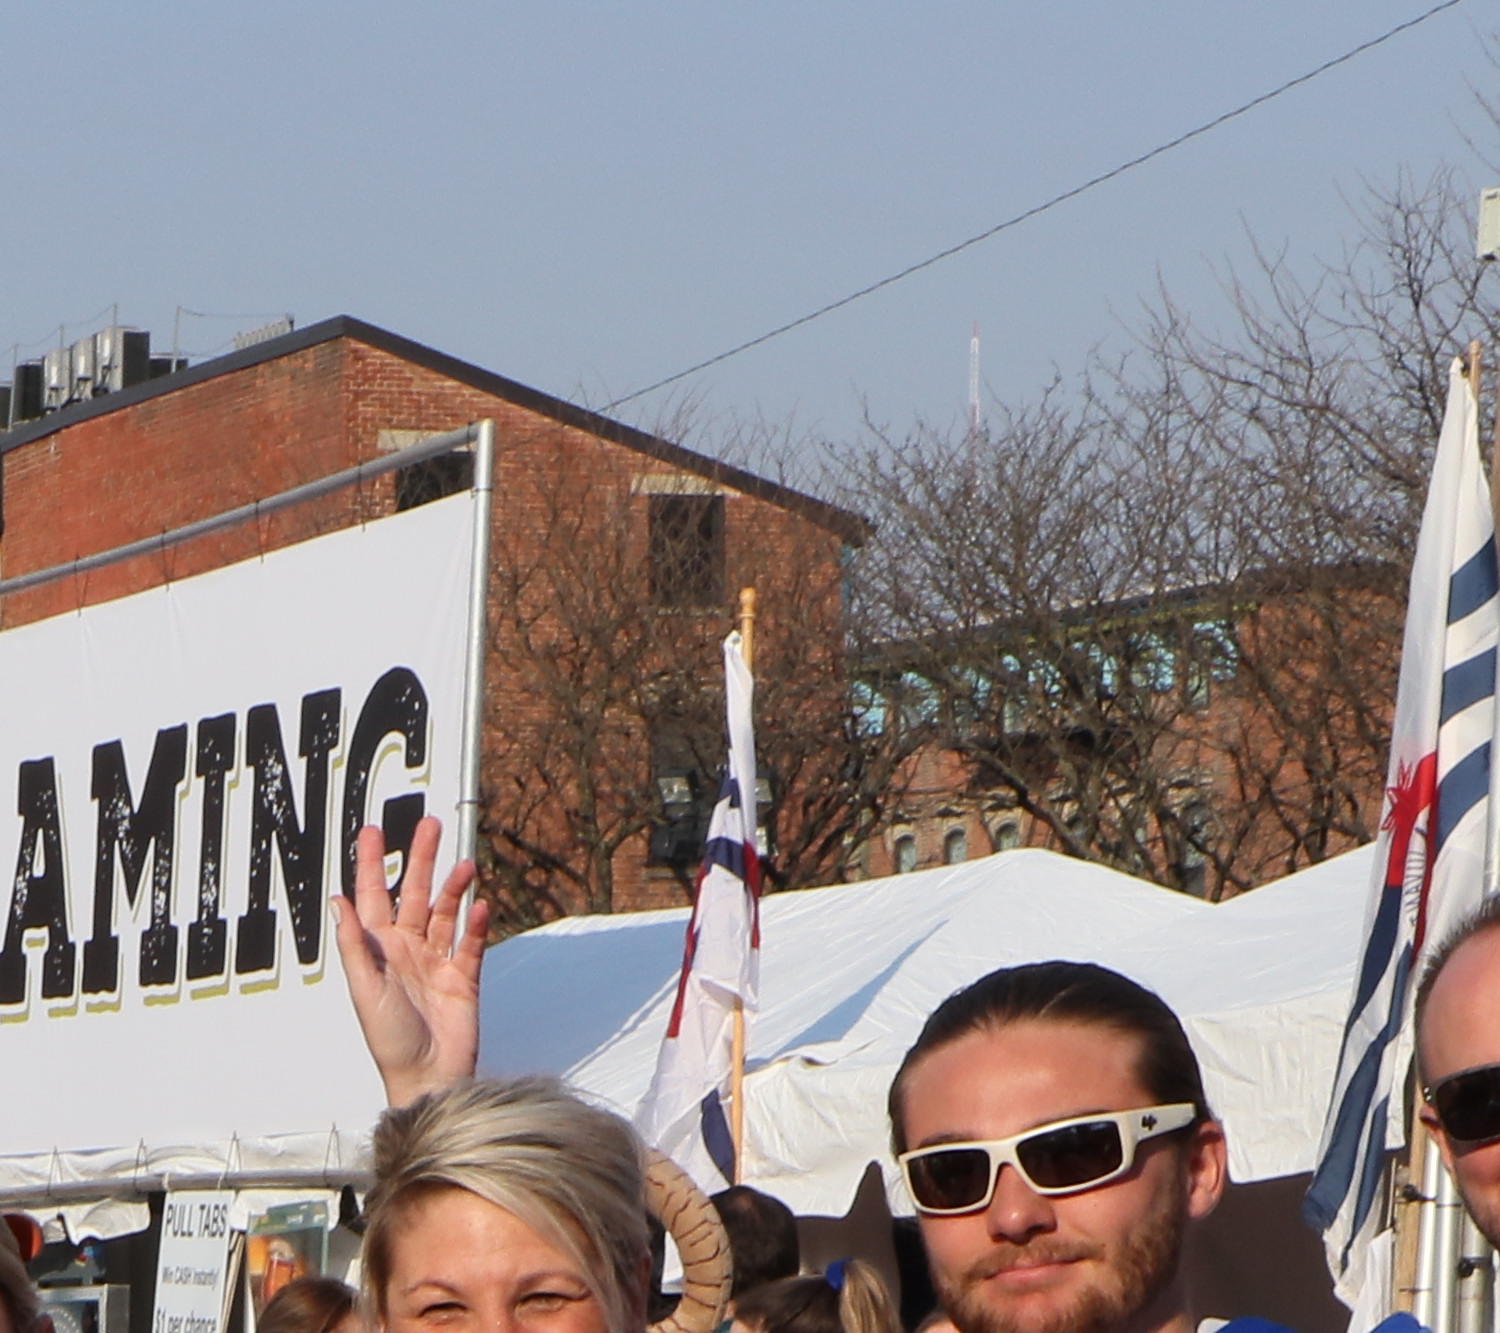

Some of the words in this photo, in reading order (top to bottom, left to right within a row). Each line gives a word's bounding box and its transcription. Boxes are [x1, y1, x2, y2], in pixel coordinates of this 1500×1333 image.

[165, 1204, 194, 1237] PULL
[200, 1204, 228, 1238] TABS
[175, 1267, 192, 1285] CASH
